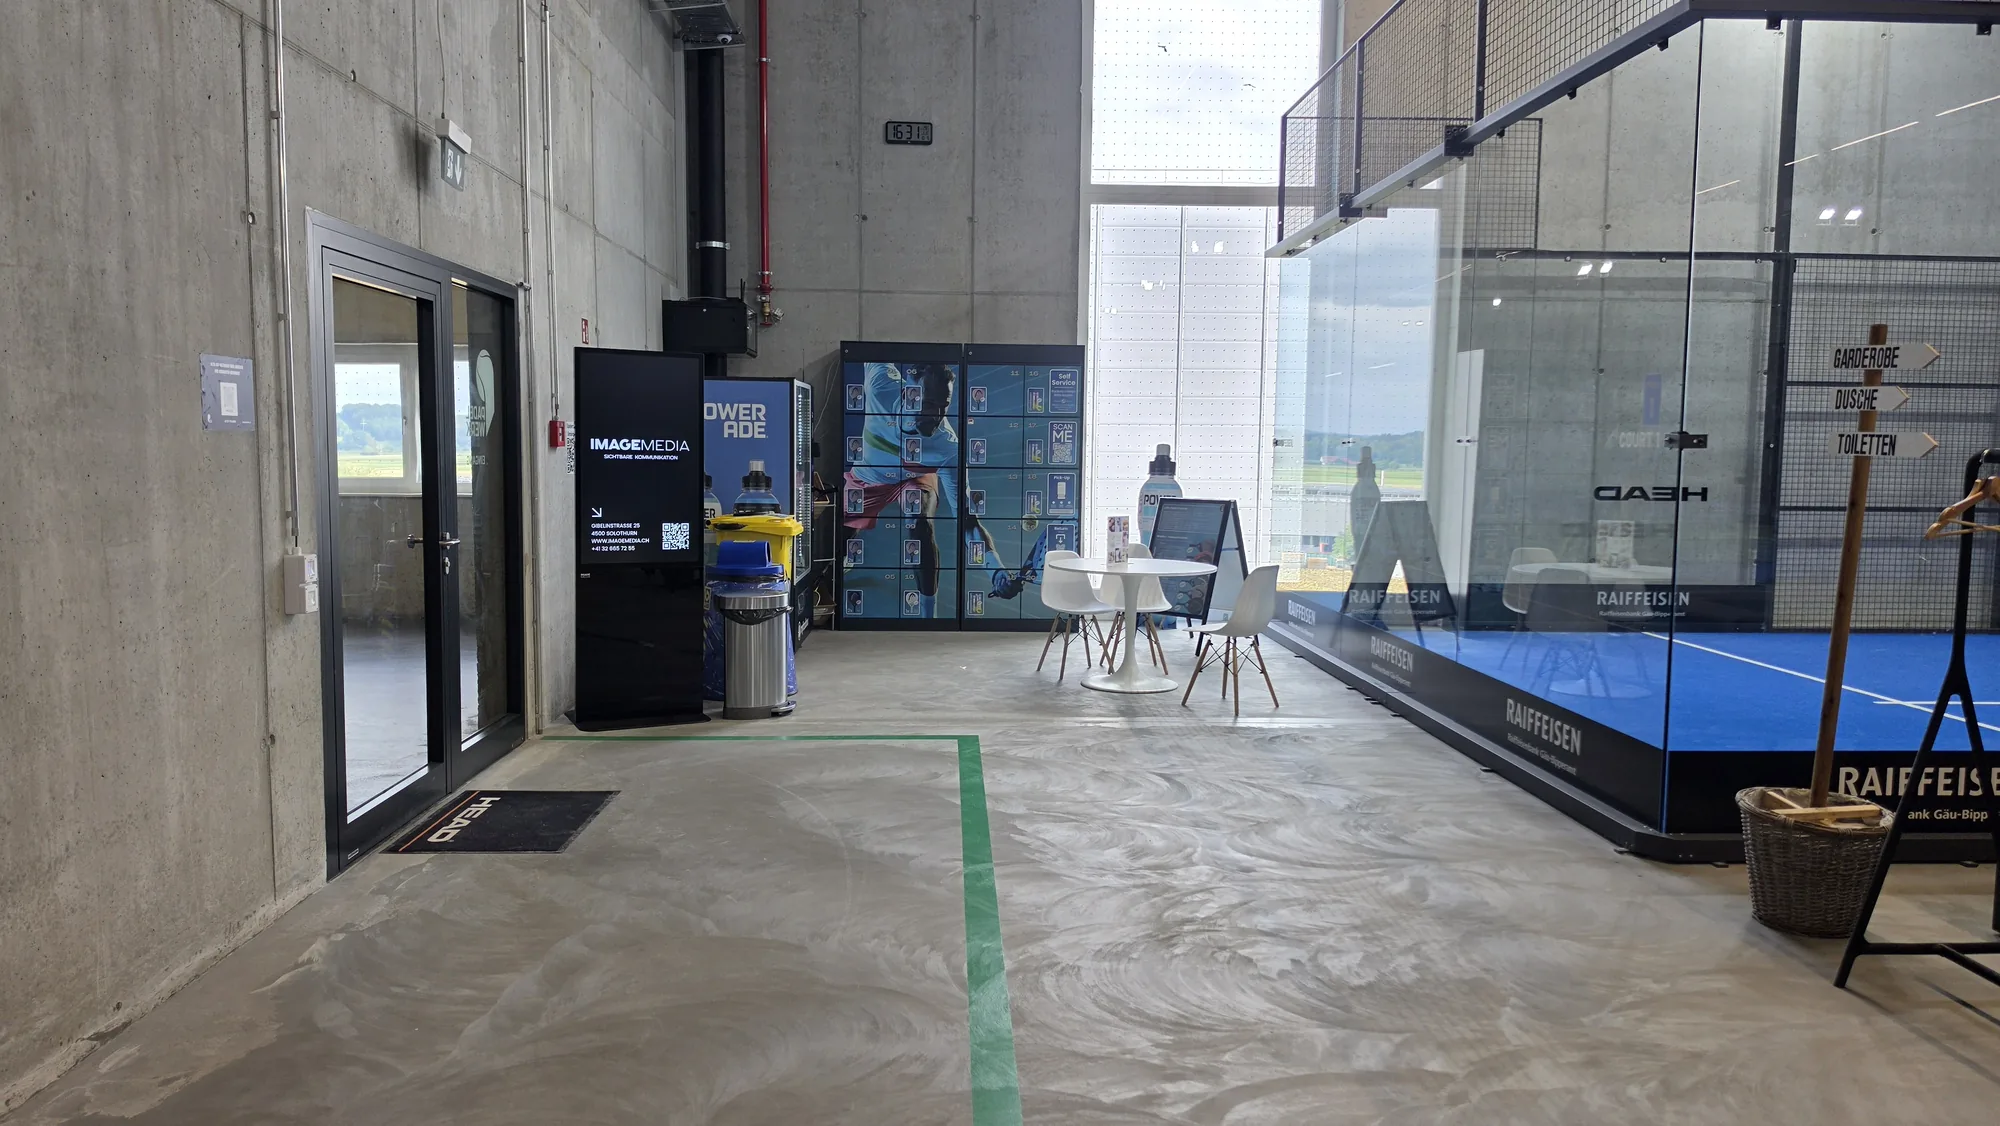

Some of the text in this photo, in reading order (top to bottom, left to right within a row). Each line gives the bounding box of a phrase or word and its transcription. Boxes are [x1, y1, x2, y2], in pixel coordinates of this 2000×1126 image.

[1833, 346, 1900, 369] GARDEROBE
[1834, 389, 1879, 410] DUSCHE
[723, 421, 766, 439] ADE
[1053, 430, 1072, 443] ME
[590, 438, 690, 452] IMAGEMEDIA
[1837, 433, 1897, 457] TOILETTEN
[1370, 635, 1414, 673] RAIFFEISEN
[1506, 698, 1581, 756] RAIFFEISEN
[427, 796, 501, 843] HEAD
